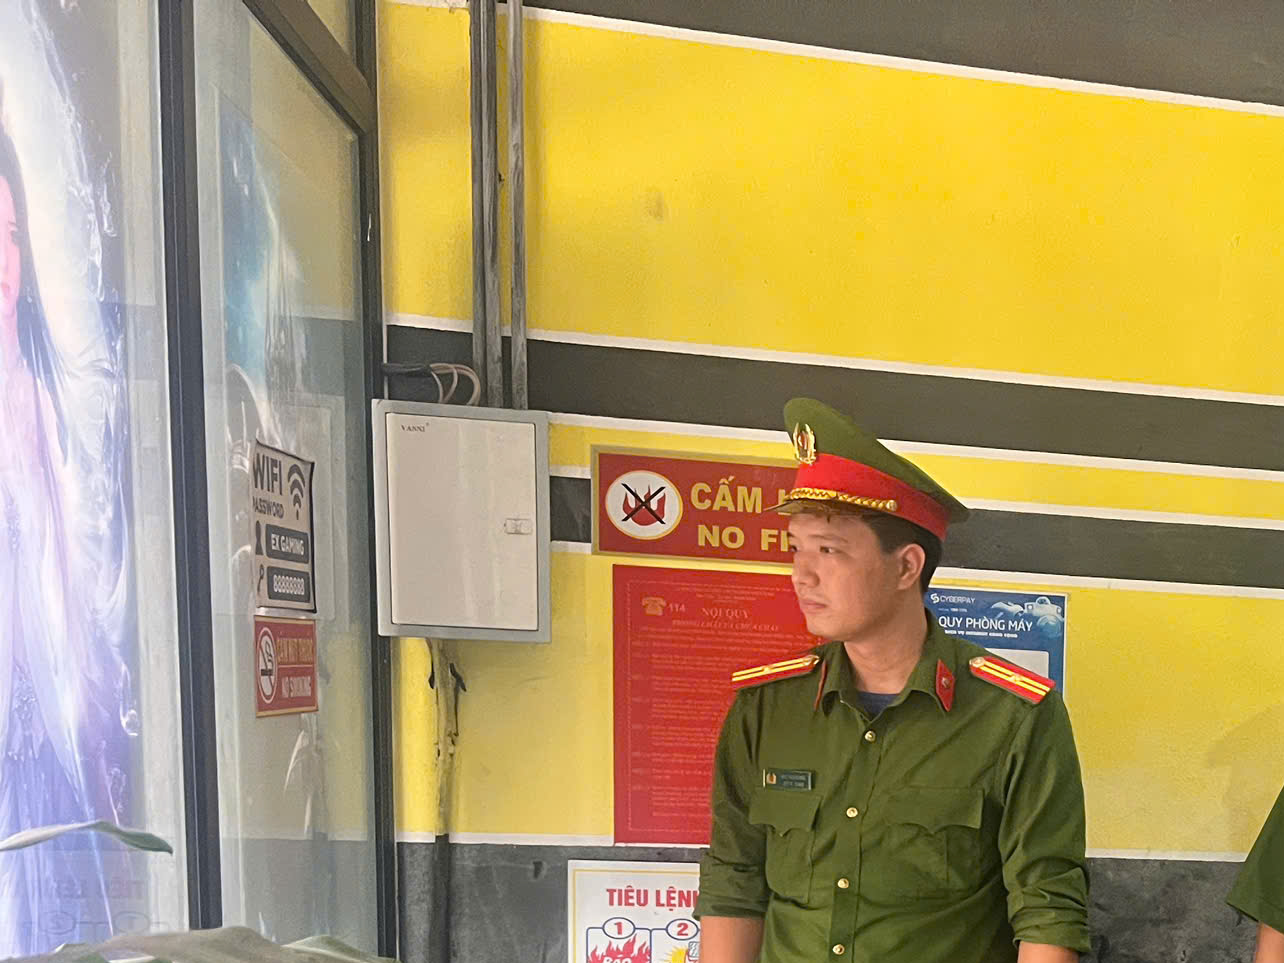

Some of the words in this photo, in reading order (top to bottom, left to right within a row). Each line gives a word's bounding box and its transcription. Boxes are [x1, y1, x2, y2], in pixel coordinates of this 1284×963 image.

[252, 452, 283, 496] WIFI
[691, 475, 762, 513] CẤM
[697, 524, 745, 549] NO
[760, 528, 789, 552] FI
[940, 595, 976, 604] CYBERPAY
[668, 603, 686, 613] 114
[938, 616, 962, 628] QUY
[965, 616, 1006, 631] PHÒNG
[1008, 618, 1033, 632] MÁY
[606, 885, 648, 907] TIÊU
[614, 921, 623, 936] 1
[676, 922, 689, 936] 2
